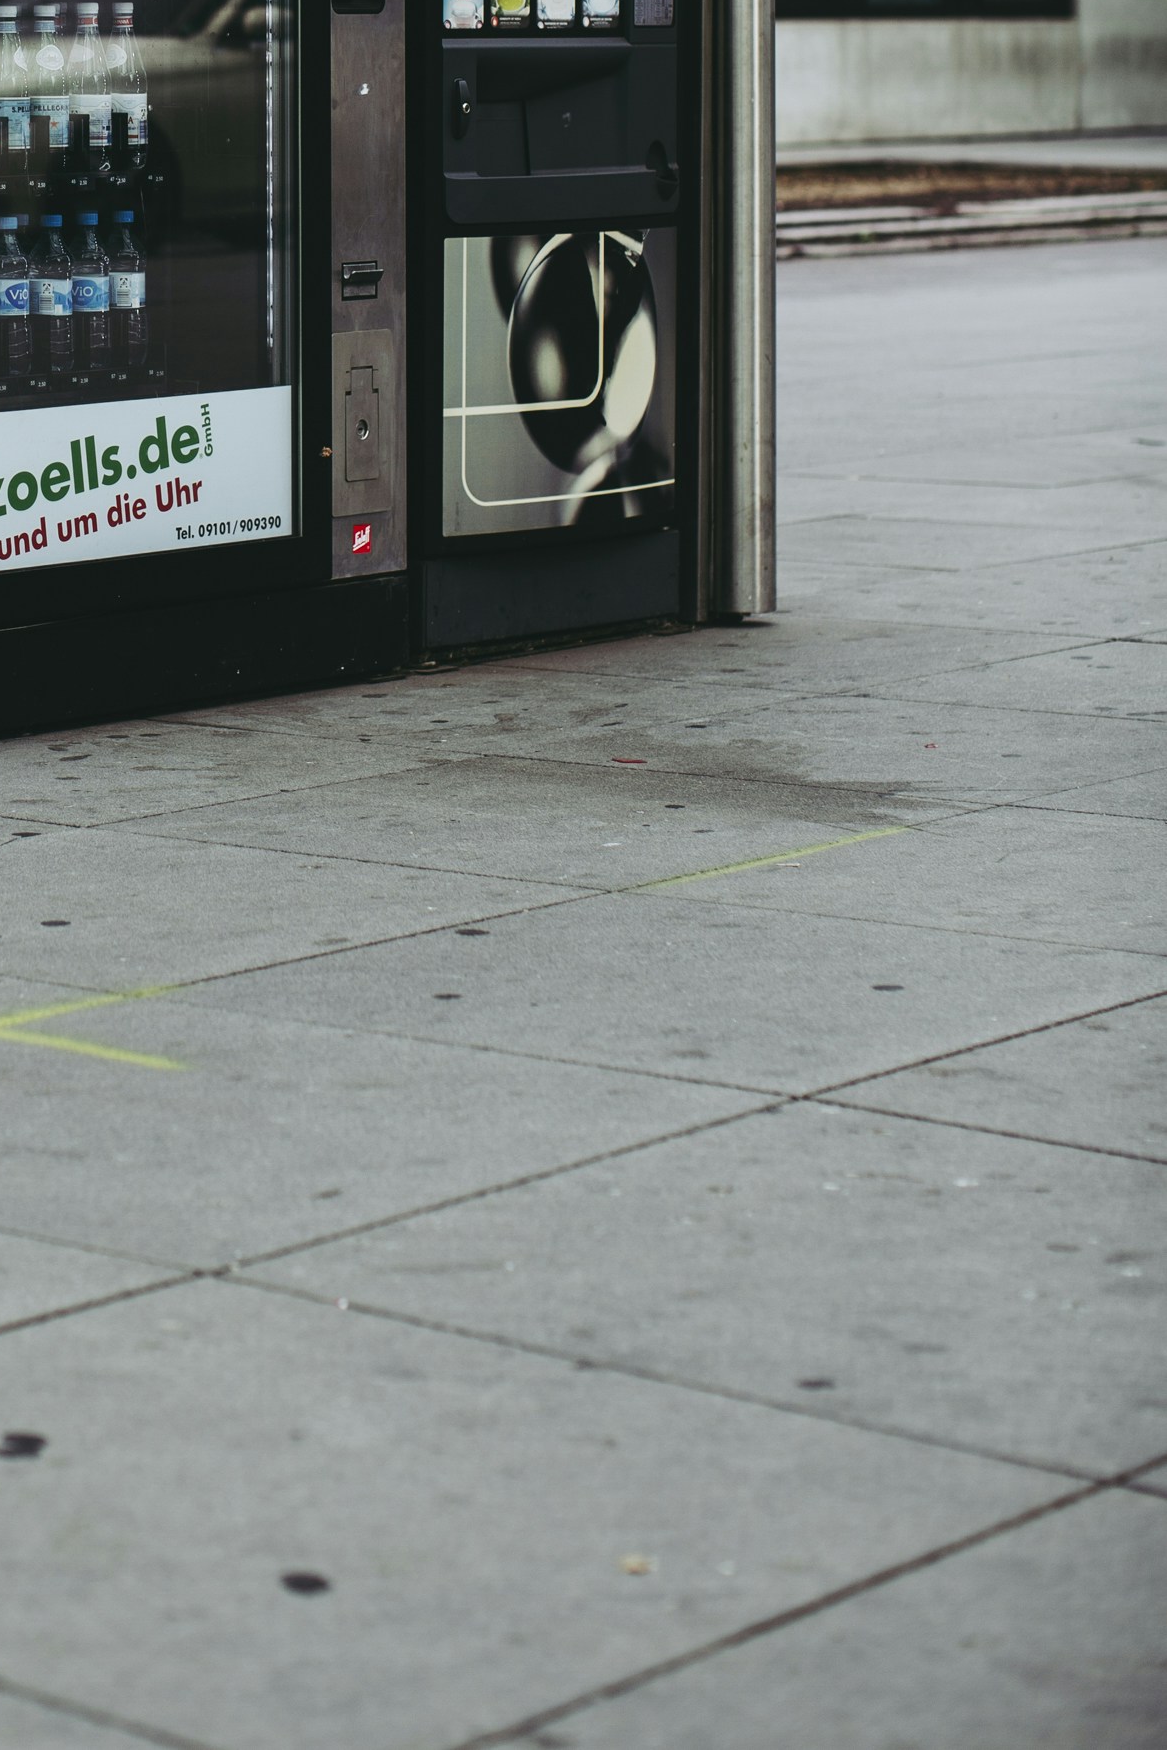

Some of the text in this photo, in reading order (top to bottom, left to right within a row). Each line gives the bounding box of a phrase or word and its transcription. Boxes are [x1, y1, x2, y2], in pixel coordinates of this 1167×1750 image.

[71, 286, 94, 298] ViO
[200, 403, 214, 456] GmbH
[58, 511, 98, 543] um
[106, 493, 147, 529] die
[155, 477, 203, 512] Uhr
[176, 516, 282, 541] Tel. 09101/909390
